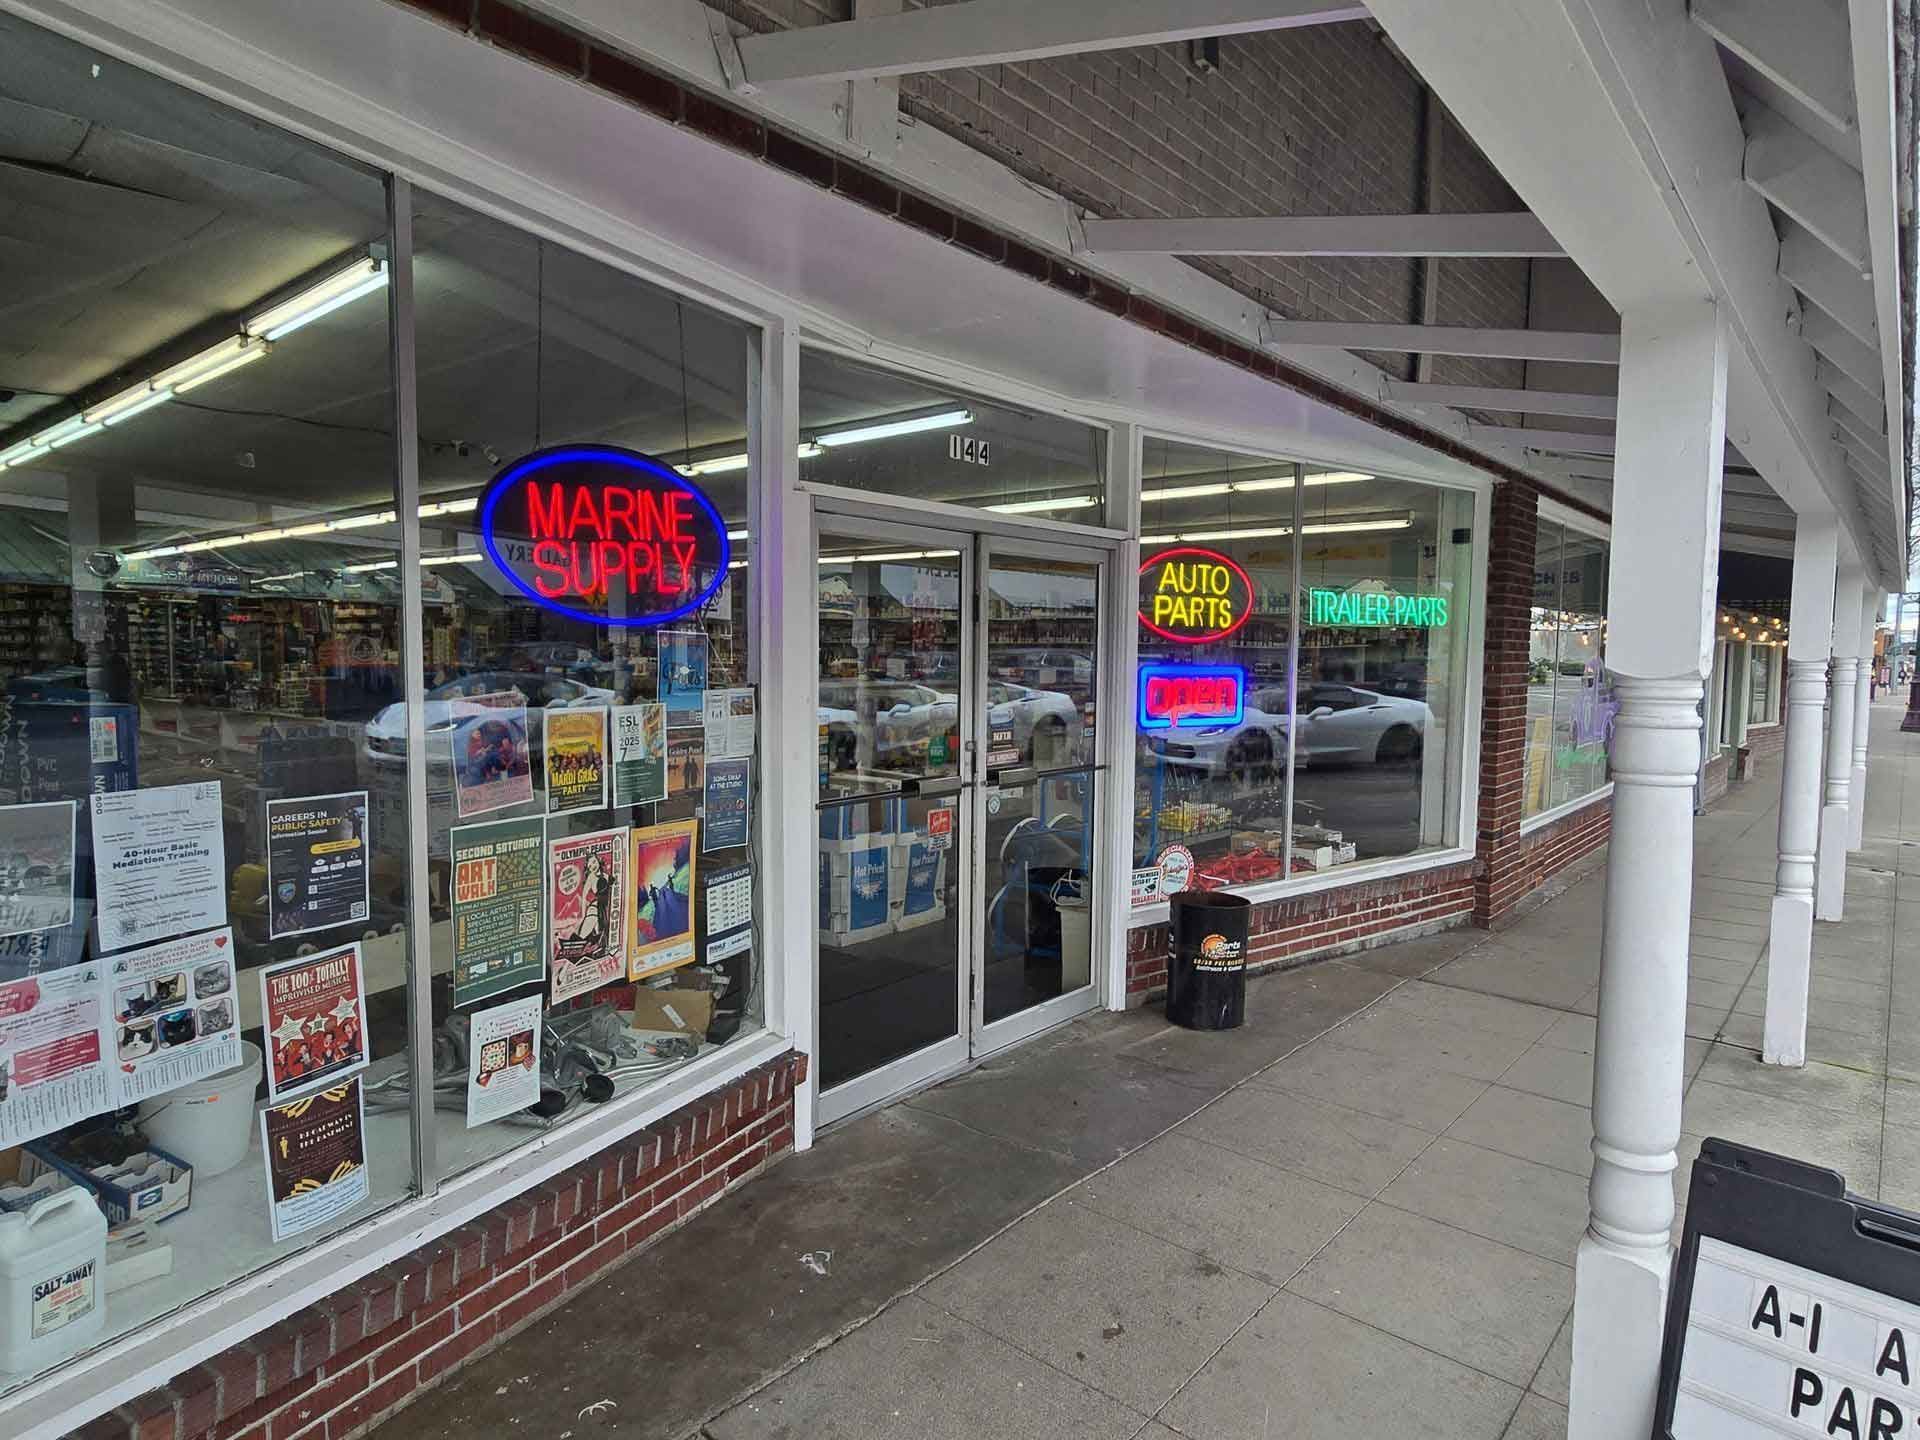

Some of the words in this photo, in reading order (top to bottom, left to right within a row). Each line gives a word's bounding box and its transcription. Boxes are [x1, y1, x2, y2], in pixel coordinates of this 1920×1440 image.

[952, 435, 988, 465] 144
[527, 481, 697, 542] MARINE
[532, 540, 697, 598] SUPPLY
[1158, 561, 1231, 595] AUTO
[1153, 594, 1233, 629] PARTS
[1312, 590, 1391, 625] TRAILER
[1393, 595, 1448, 627] PARTS
[619, 715, 639, 728] ESL
[619, 736, 640, 747] 2025
[552, 769, 577, 786] MARDI
[577, 764, 599, 783] GRAS
[562, 784, 587, 796] PARTY
[271, 811, 316, 824] CAREERS
[317, 810, 328, 818] IN
[271, 820, 308, 833] PUBLIC
[308, 816, 342, 828] SAFETY
[112, 855, 165, 870] Mediation
[167, 848, 210, 861] Training
[123, 846, 168, 859] 40-Hour
[170, 840, 199, 852] Basic
[456, 845, 494, 862] SECOND
[495, 836, 541, 855] SATURDAY
[560, 845, 590, 861] OLYMPIC
[590, 841, 611, 856] PEAKS
[457, 858, 497, 886] ART
[708, 871, 733, 886] BUSINESS
[457, 879, 496, 902] WALK
[271, 976, 289, 996] THE
[314, 957, 350, 984] TOTALLY
[272, 984, 321, 1006] IMPROVISED
[321, 974, 351, 990] MUSICAL
[299, 1134, 315, 1149] THE
[34, 1261, 95, 1302] SALT-AWAY
[1790, 1367, 1920, 1440] PAR
